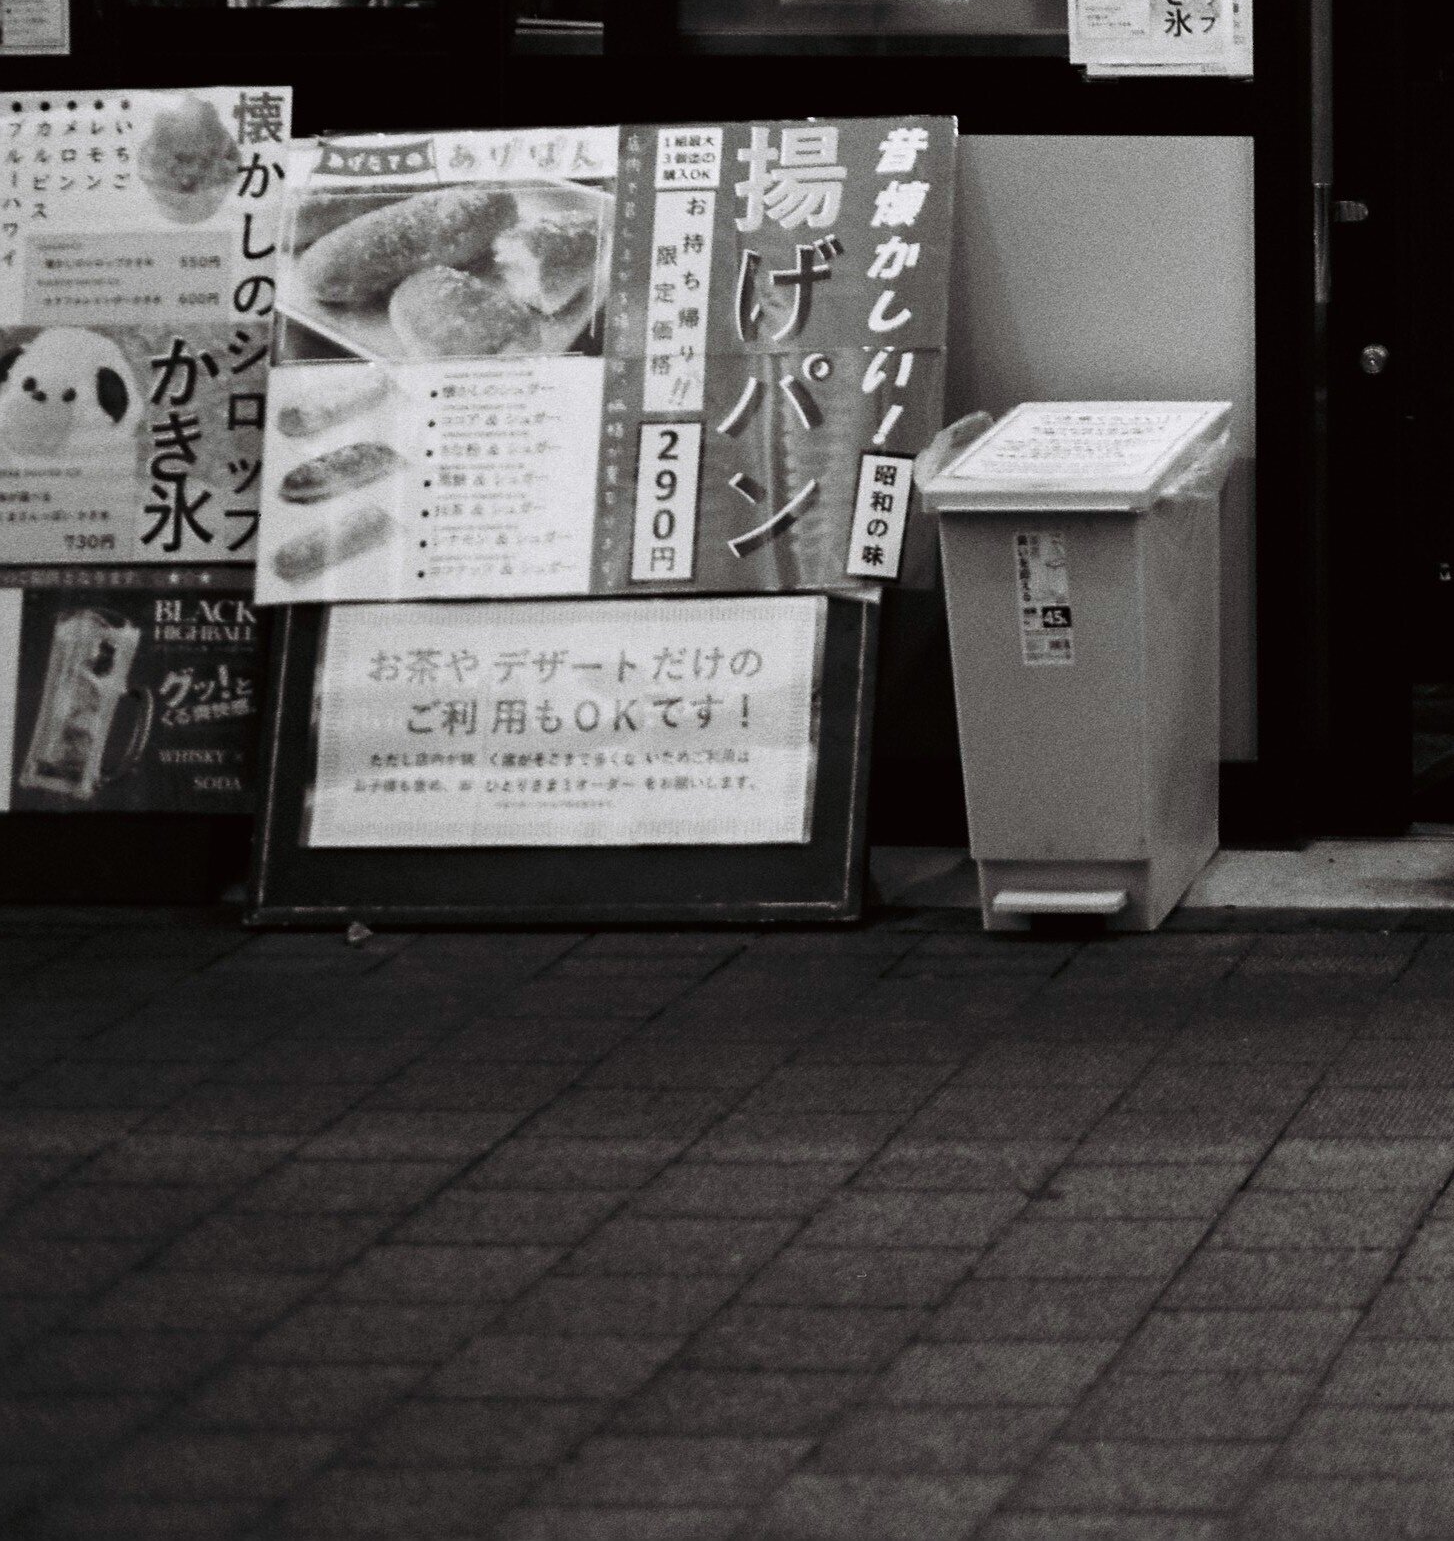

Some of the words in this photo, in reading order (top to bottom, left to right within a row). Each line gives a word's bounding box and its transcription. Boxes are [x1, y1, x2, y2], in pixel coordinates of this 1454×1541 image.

[60, 119, 78, 191] メロン
[86, 119, 104, 191] レモン
[113, 120, 133, 190] いちご
[651, 244, 678, 375] 限定価格
[716, 125, 848, 559] 揚げパン
[141, 338, 220, 553] かき氷
[650, 429, 679, 572] 290円
[861, 463, 898, 567] 昭和の味
[154, 599, 257, 623] BLACK
[194, 775, 242, 792] SODA
